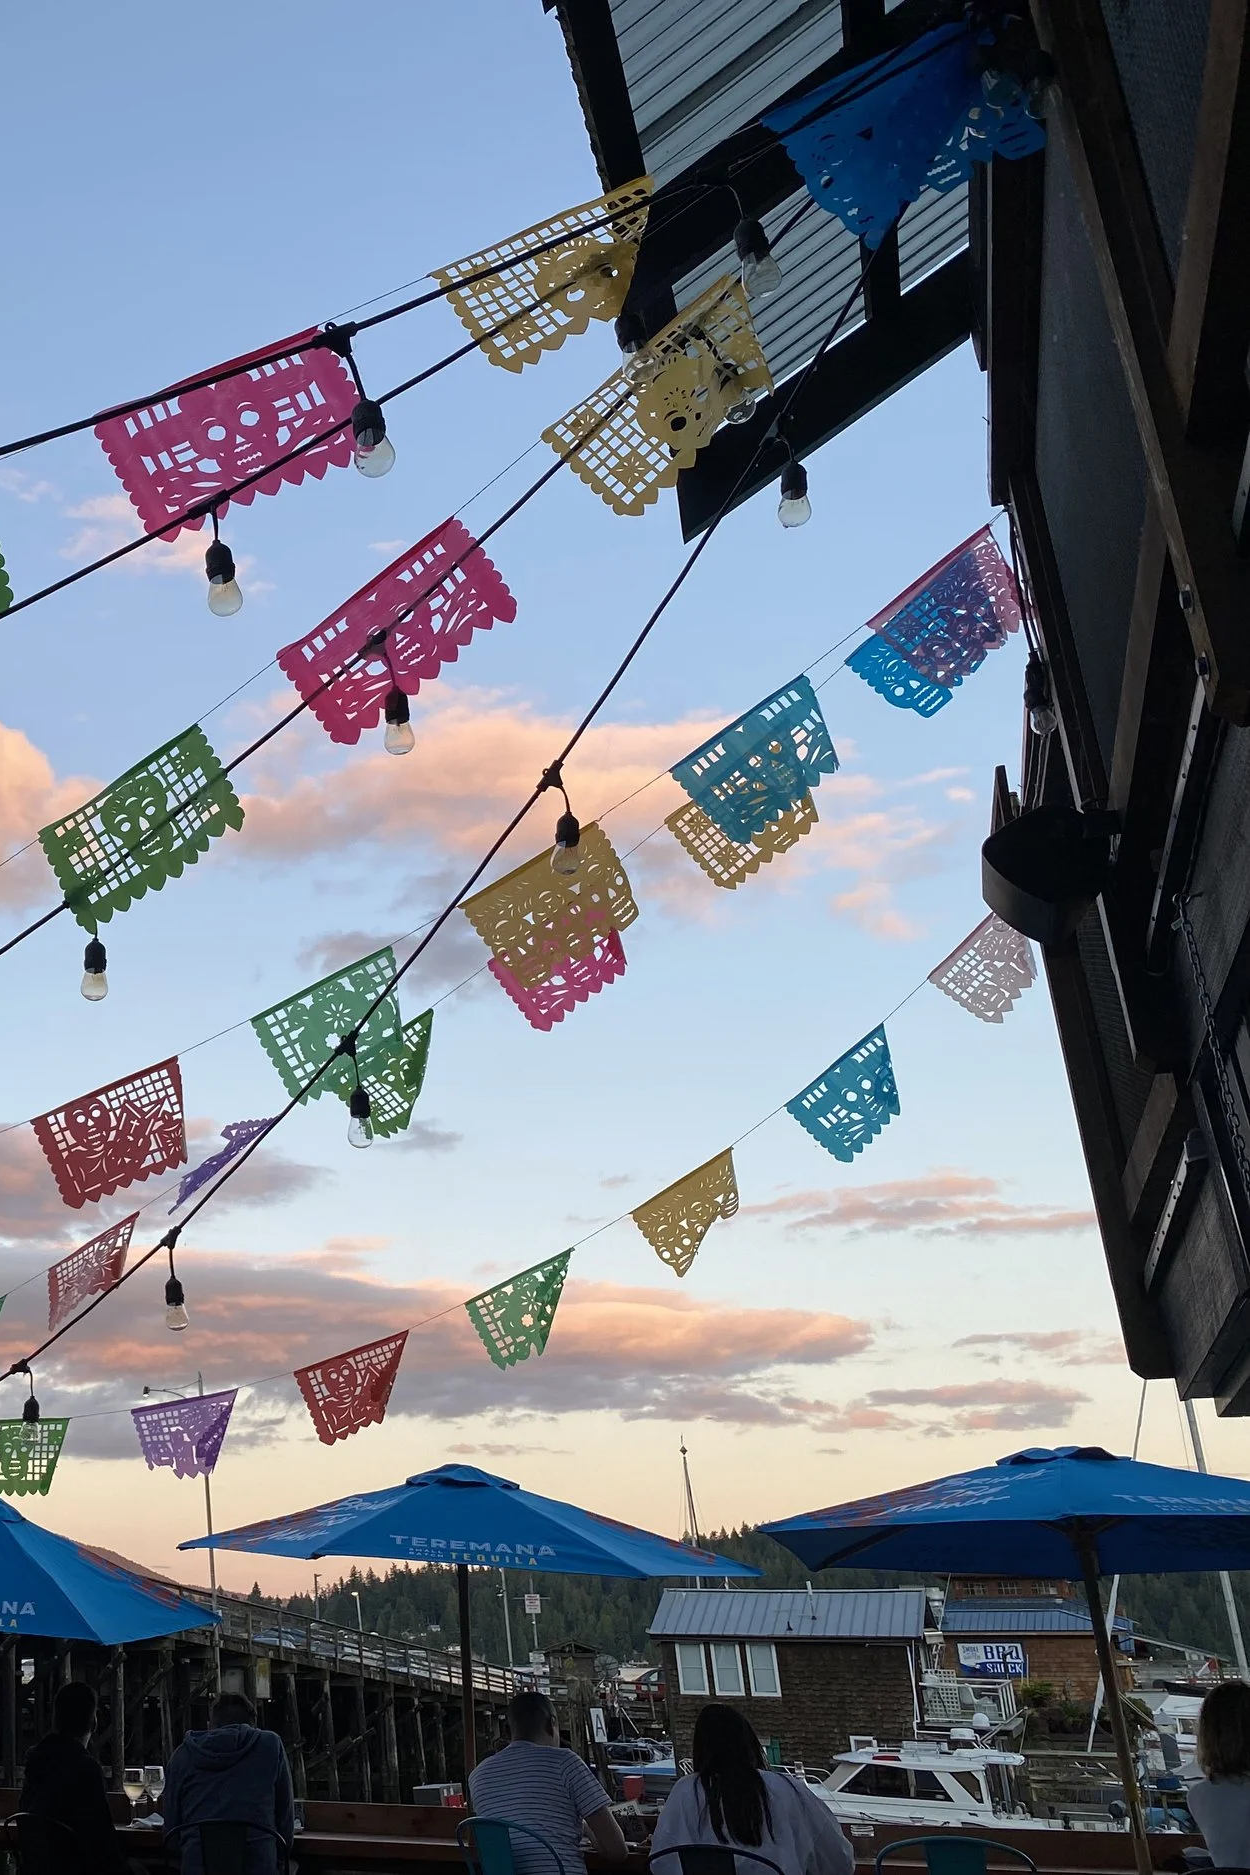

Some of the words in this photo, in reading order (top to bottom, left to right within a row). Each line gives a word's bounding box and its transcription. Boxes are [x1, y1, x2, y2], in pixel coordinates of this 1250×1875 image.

[389, 1534, 557, 1556] TEREMANA
[450, 1552, 538, 1566] TEQUILA
[595, 1714, 605, 1736] A
